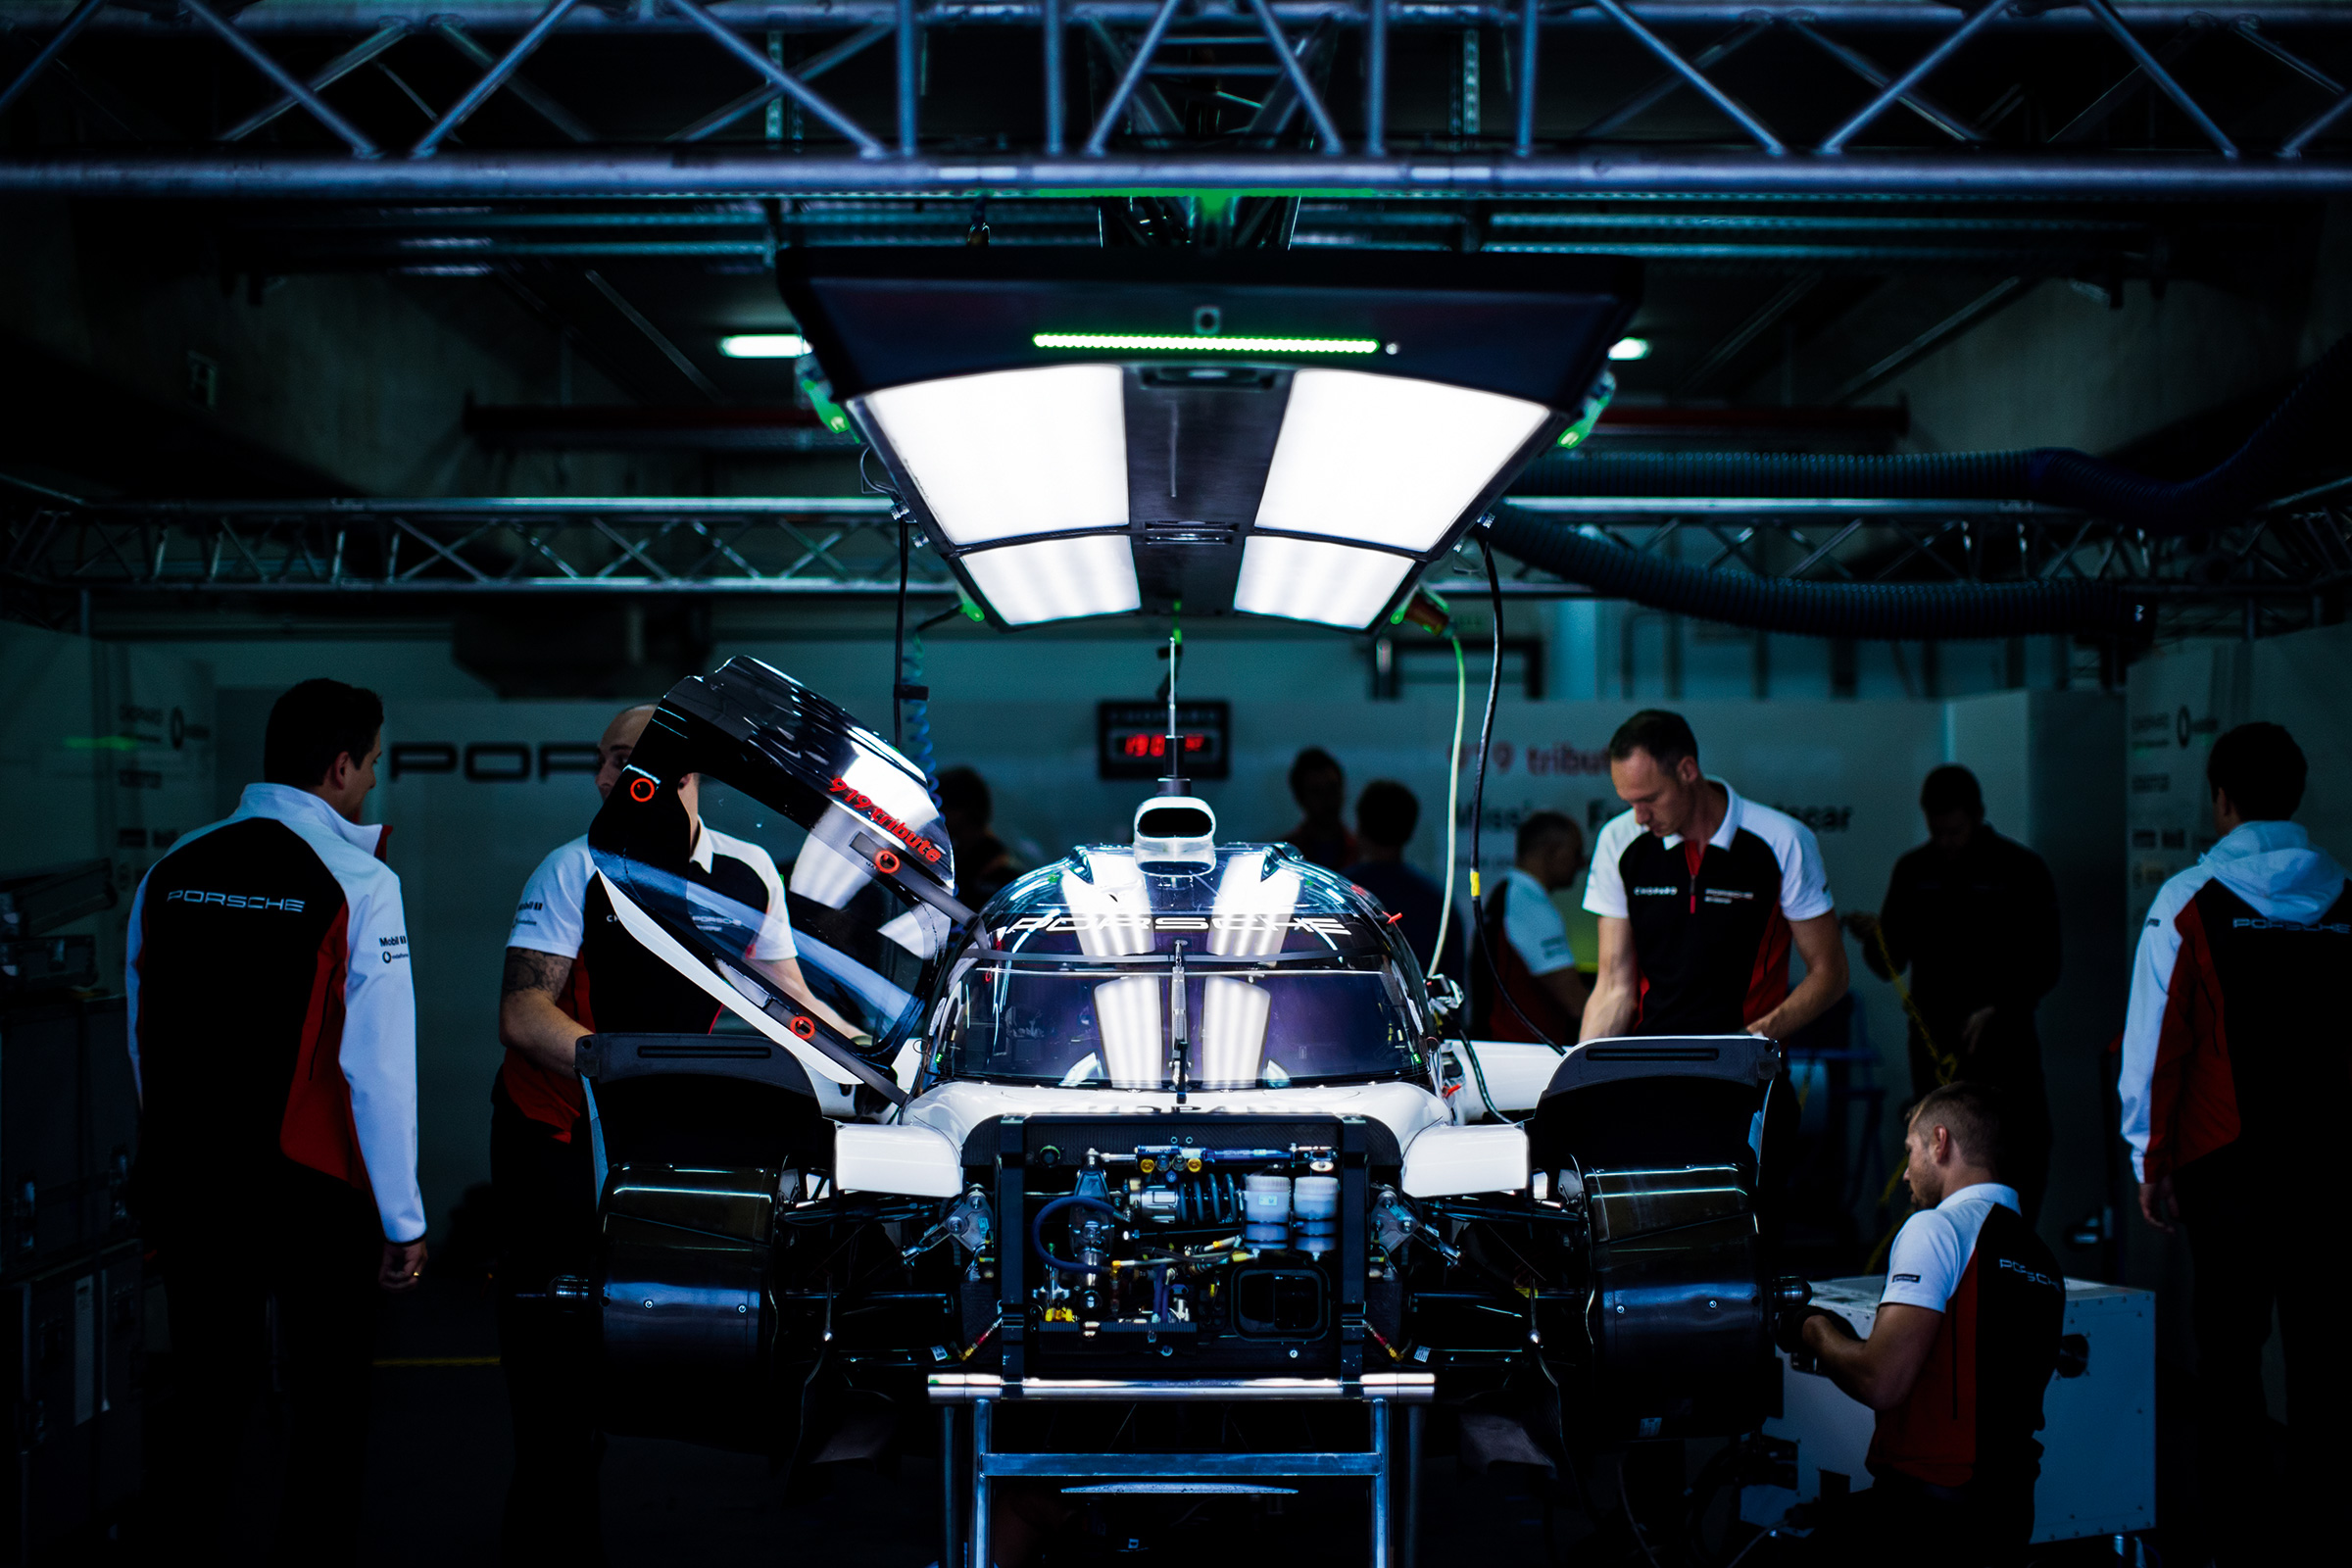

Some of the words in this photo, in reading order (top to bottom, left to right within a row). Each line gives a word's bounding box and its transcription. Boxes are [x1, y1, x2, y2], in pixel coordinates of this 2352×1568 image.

[829, 777, 872, 808] 919
[870, 808, 943, 862] tribute
[166, 889, 306, 913] PORSCHE
[1005, 917, 1351, 936] PORSCHE
[379, 936, 399, 947] Mobil
